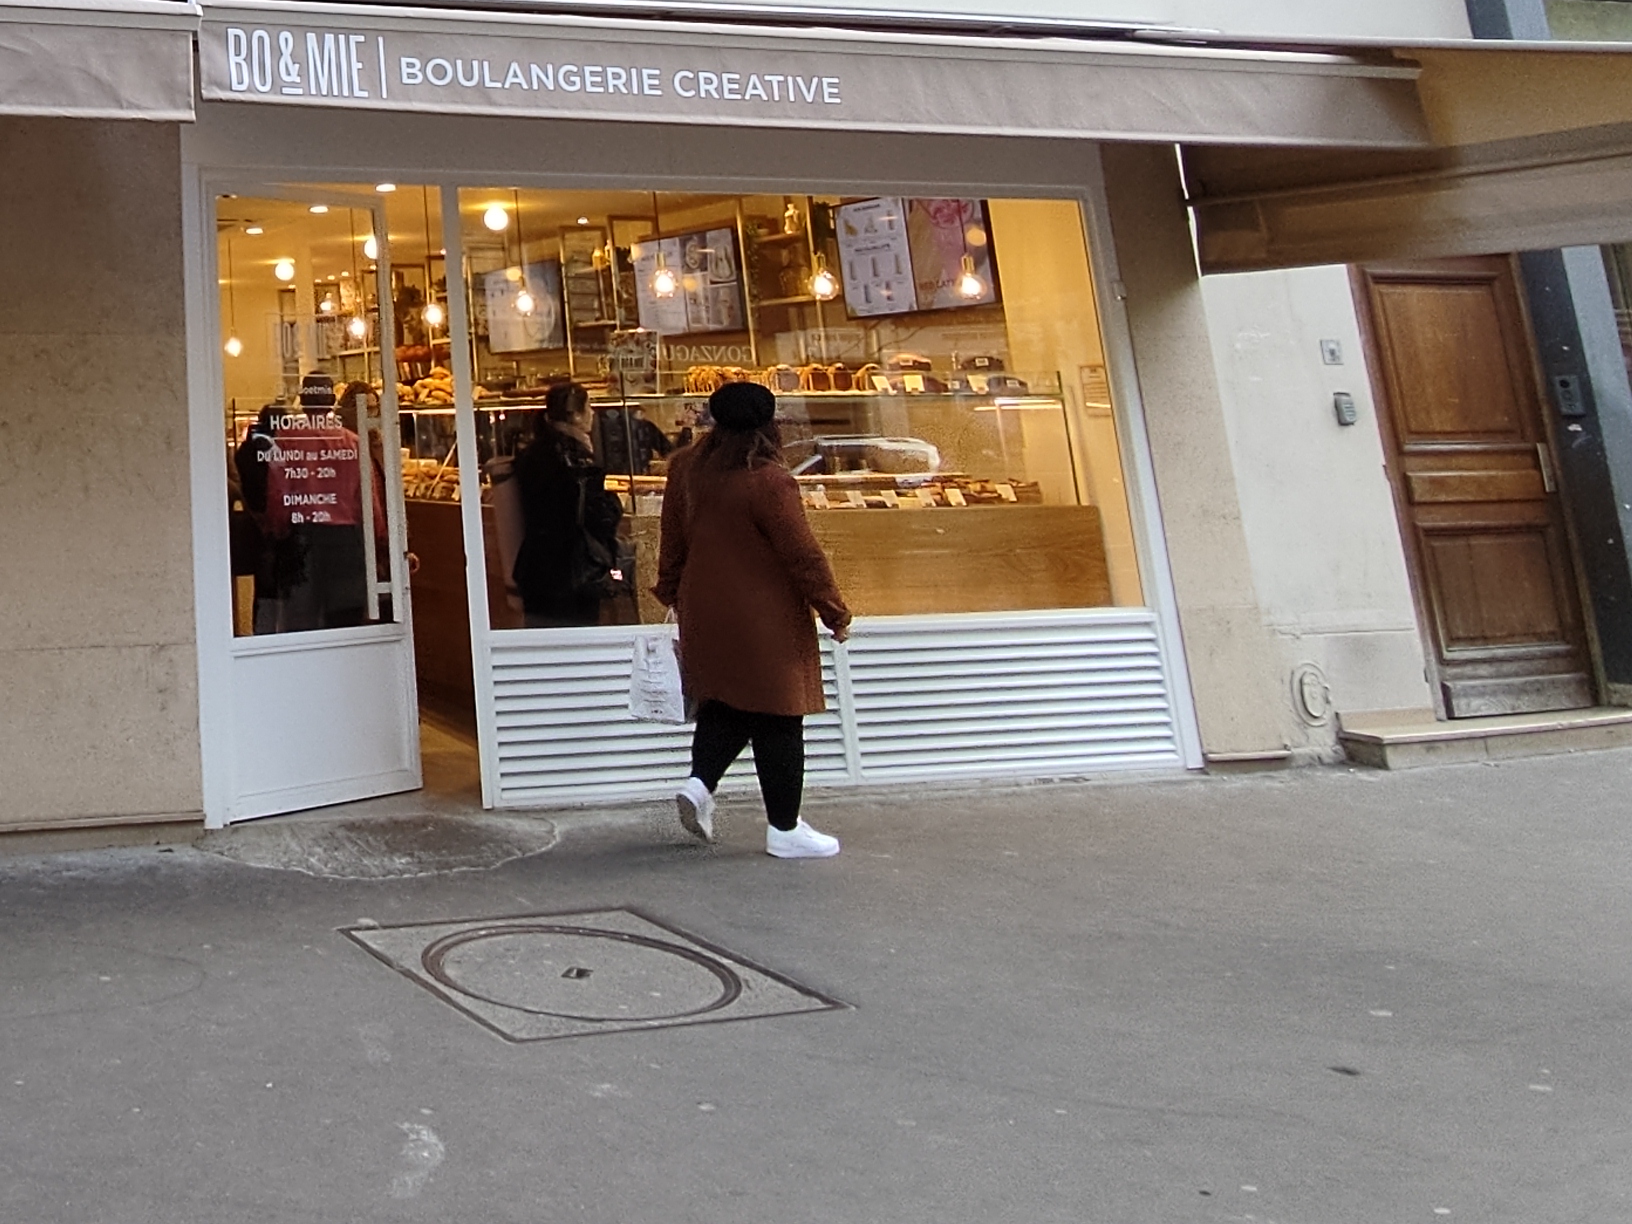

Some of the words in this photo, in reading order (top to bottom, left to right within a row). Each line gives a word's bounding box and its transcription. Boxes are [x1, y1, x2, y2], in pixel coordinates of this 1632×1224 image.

[399, 56, 662, 97] BOULANGERIE
[673, 70, 842, 105] CREATIVE
[270, 415, 343, 430] HORAIRES
[273, 451, 304, 462] LUNDI
[320, 449, 358, 461] SAMEDI
[284, 468, 309, 479] 7h30
[317, 467, 336, 478] 20h
[283, 493, 337, 506] DIMANCHE
[312, 511, 331, 523] 20h
